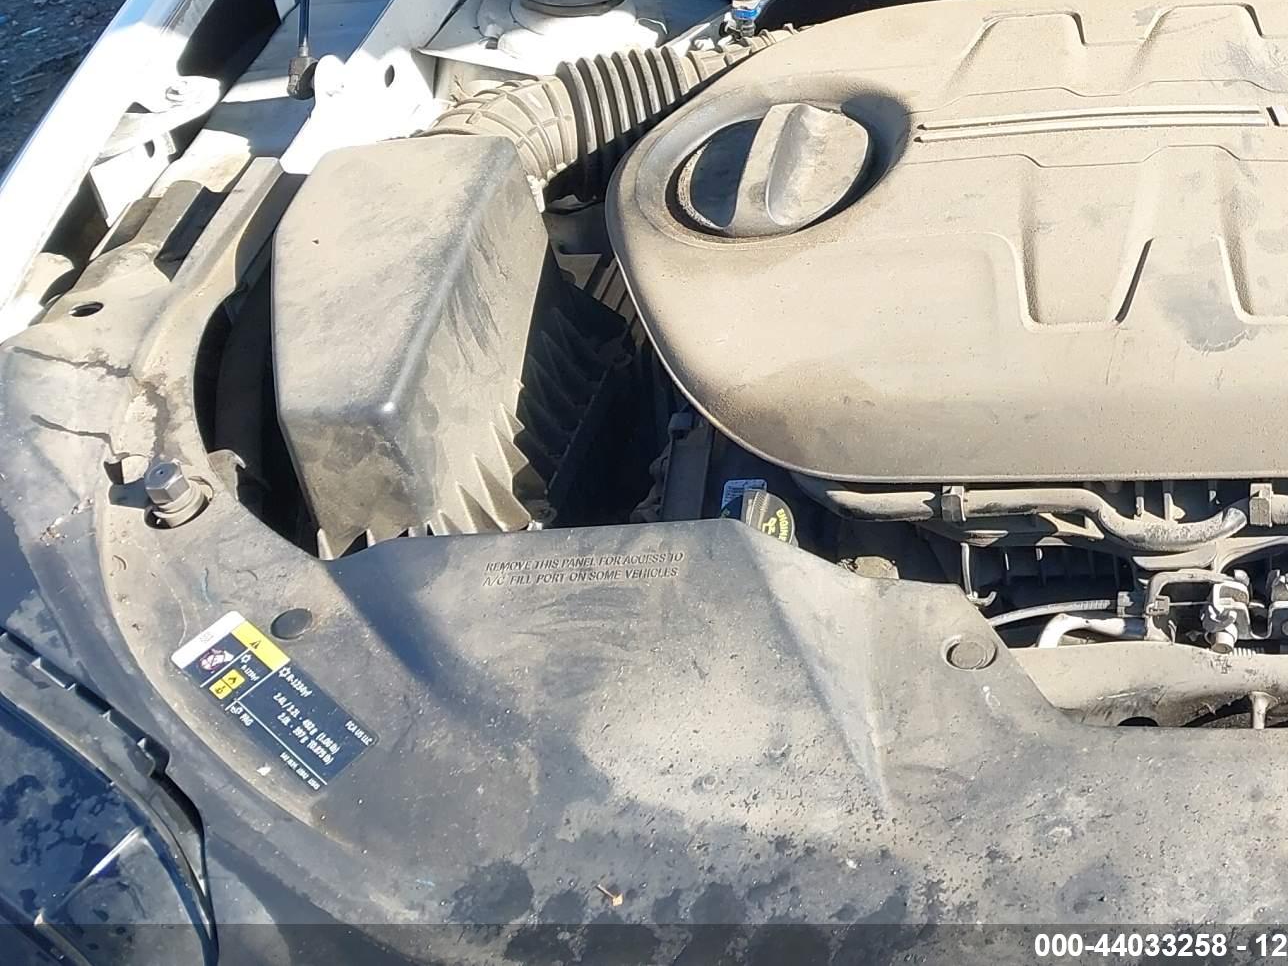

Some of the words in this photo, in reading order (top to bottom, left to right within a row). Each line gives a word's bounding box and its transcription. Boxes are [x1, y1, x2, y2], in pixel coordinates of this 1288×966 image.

[486, 561, 531, 572] REMOVE
[533, 559, 560, 570] THIS
[561, 557, 595, 568] PANEL
[599, 554, 622, 566] FOR
[623, 552, 665, 564] ACCESS
[668, 552, 684, 562] TO
[483, 575, 505, 586] A/C
[510, 574, 531, 584] FILL
[536, 572, 566, 583] PORT
[569, 571, 586, 582] ON
[588, 569, 622, 581] SOME
[625, 567, 679, 579] VEHICLES
